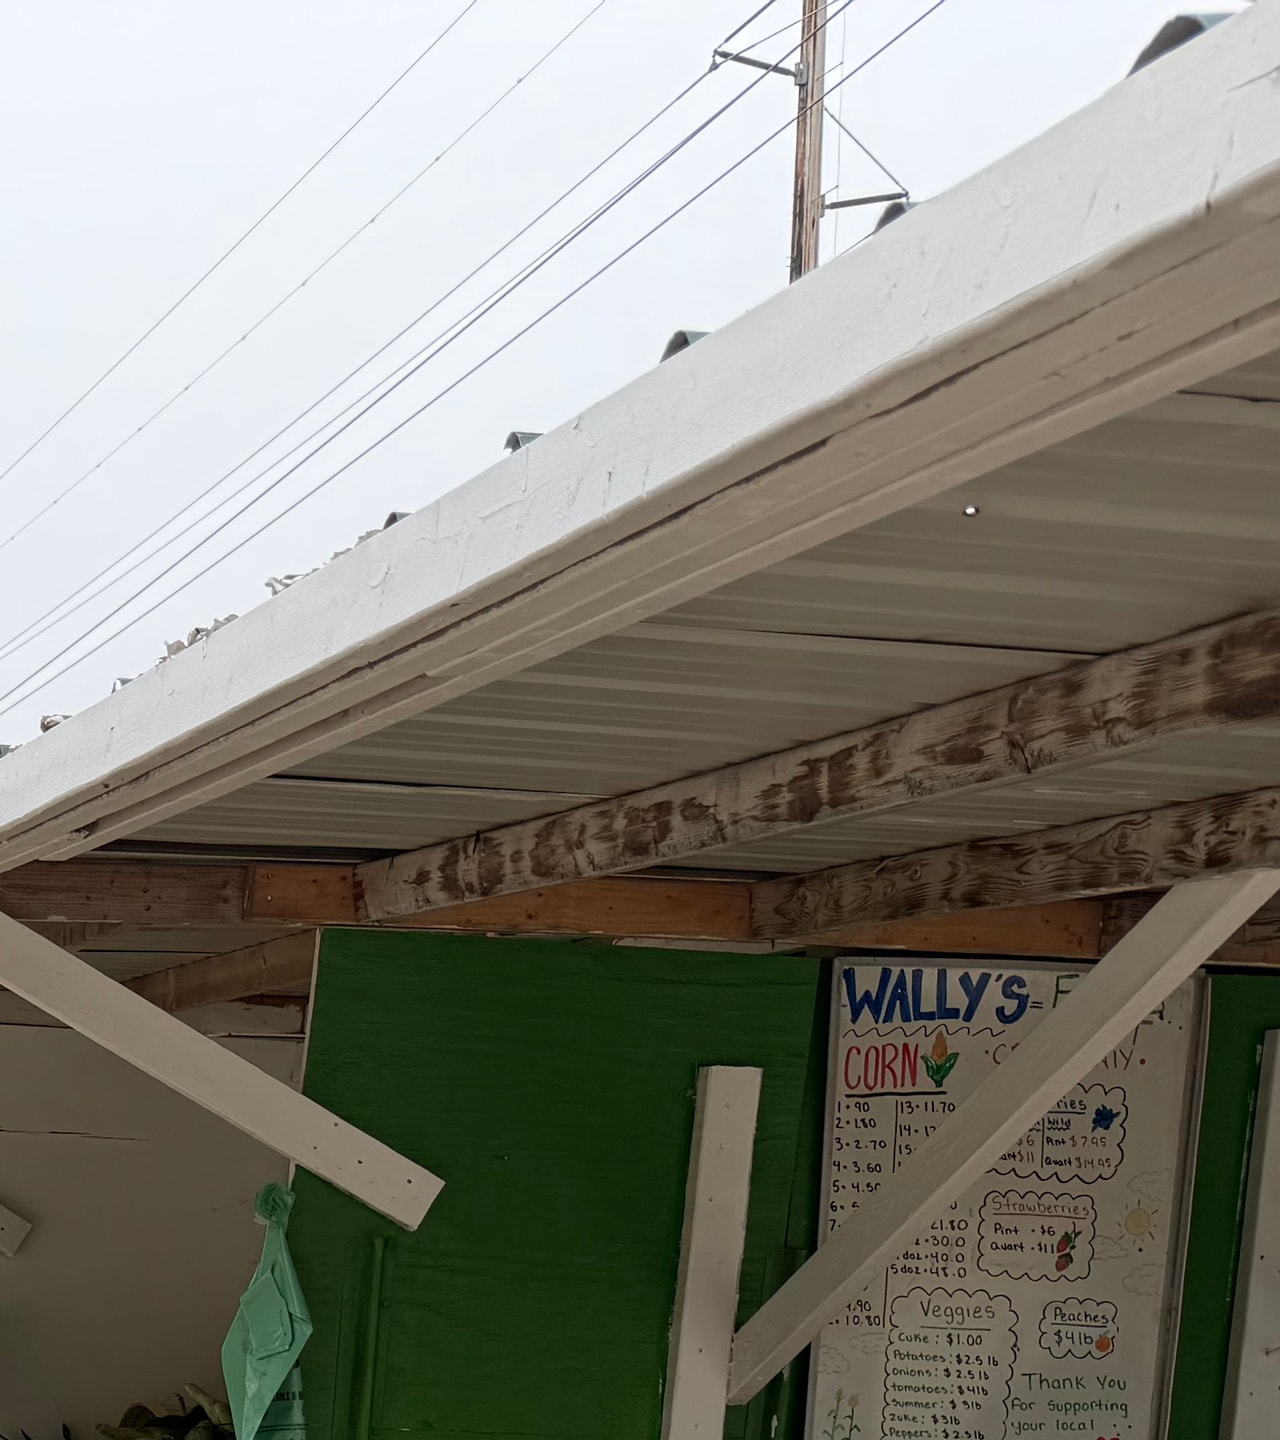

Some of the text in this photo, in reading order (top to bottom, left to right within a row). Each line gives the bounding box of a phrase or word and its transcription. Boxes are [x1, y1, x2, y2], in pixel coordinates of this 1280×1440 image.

[843, 967, 1030, 1025] WALLY'S
[844, 1043, 919, 1091] CORN
[854, 1139, 888, 1151] 2.70
[852, 1160, 882, 1174] 3.60
[992, 1195, 1089, 1216] Strawberries
[994, 1222, 1020, 1236] Pint
[920, 1298, 995, 1325] Veggies
[1054, 1306, 1109, 1324] Peaches
[845, 1314, 881, 1327] 10.80
[946, 1332, 983, 1347] $1.00
[1021, 1372, 1086, 1391] Thank
[1011, 1419, 1095, 1436] your local
